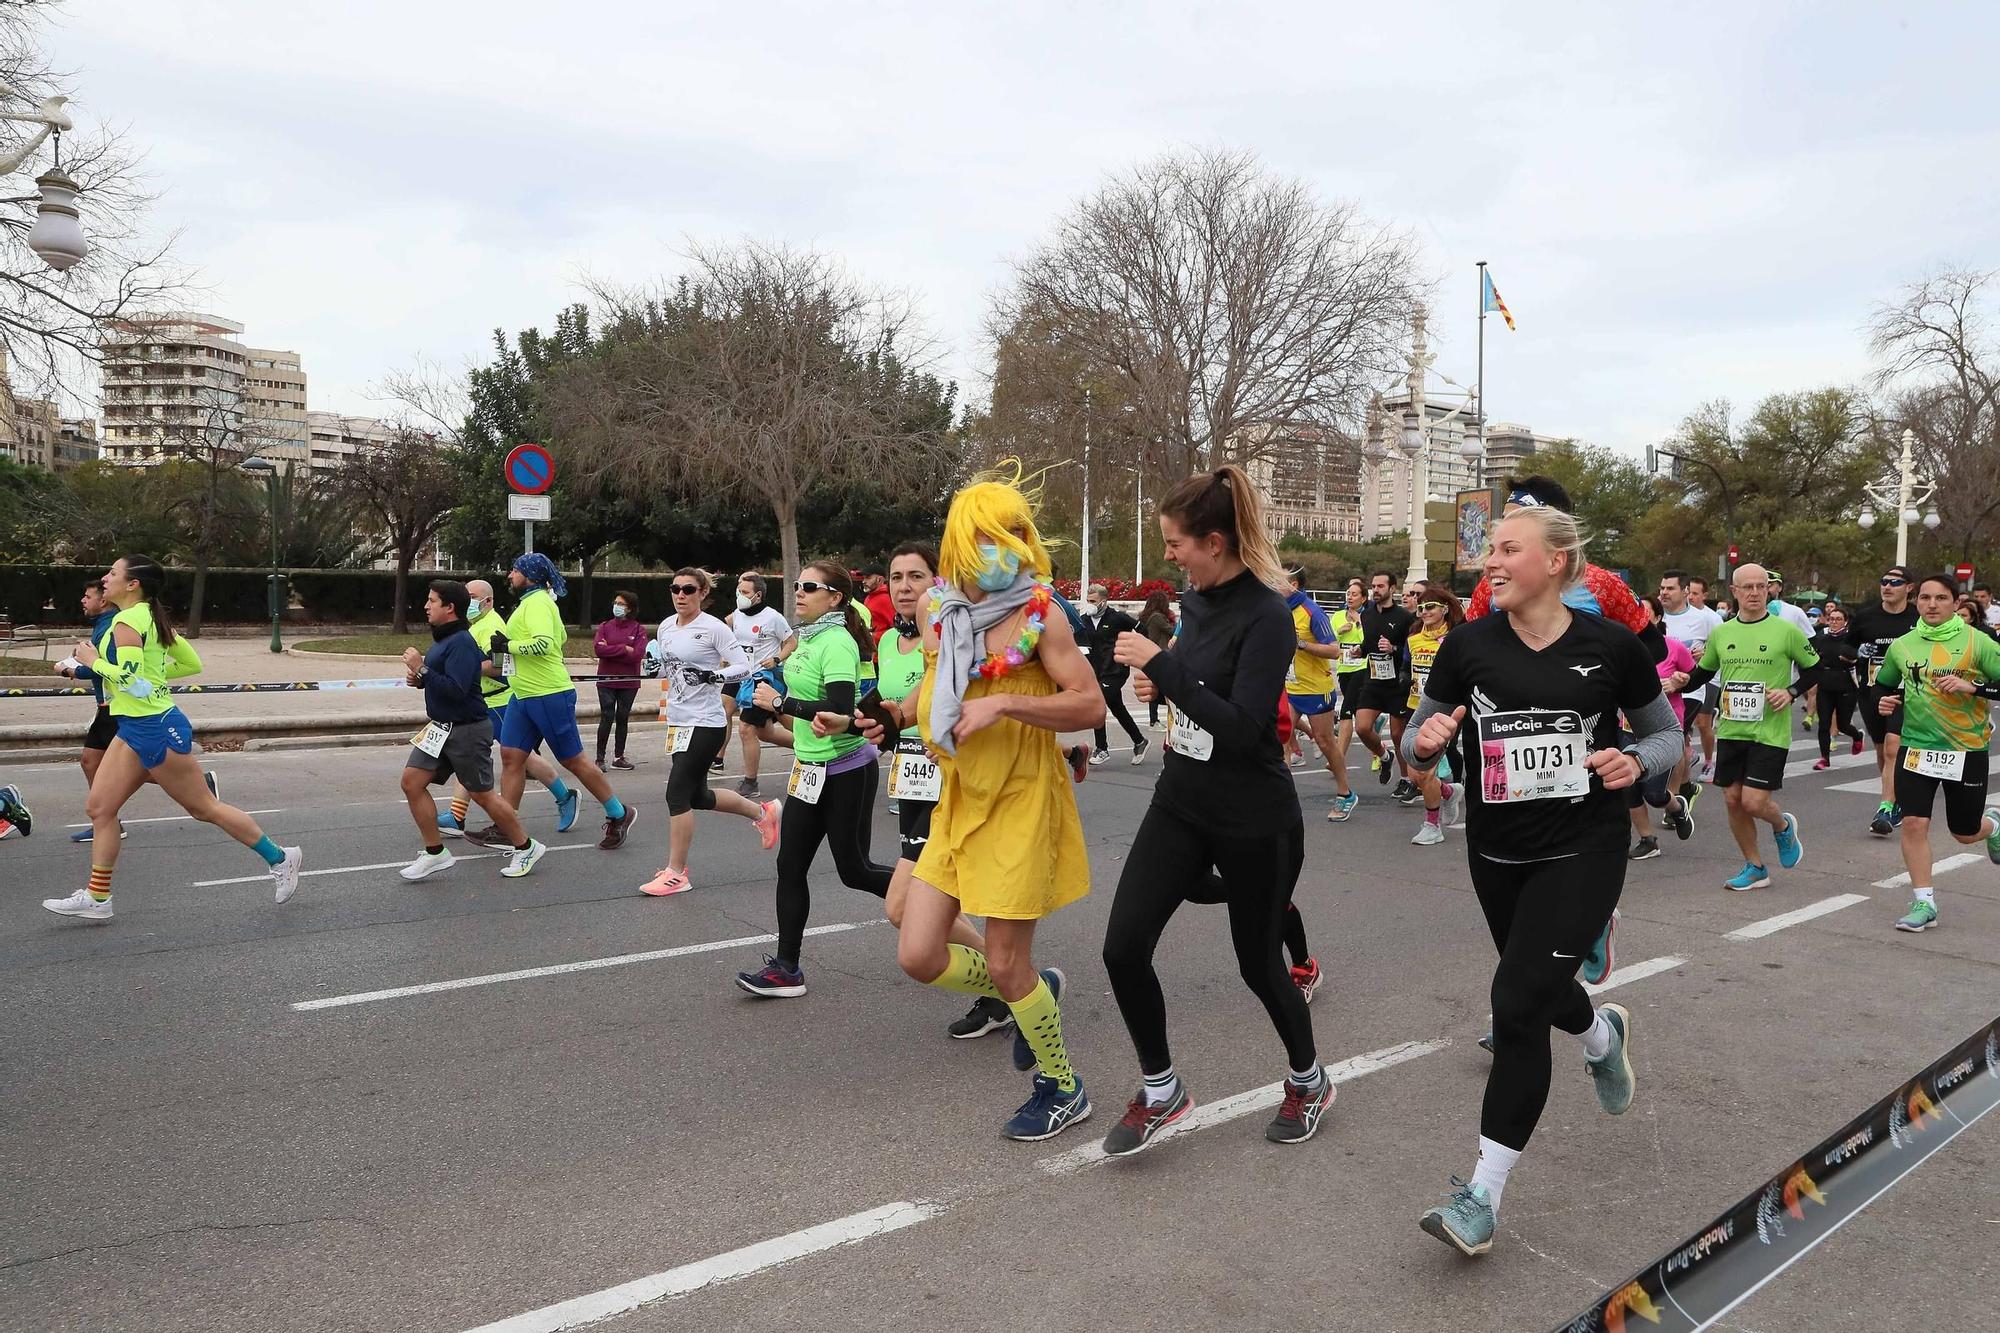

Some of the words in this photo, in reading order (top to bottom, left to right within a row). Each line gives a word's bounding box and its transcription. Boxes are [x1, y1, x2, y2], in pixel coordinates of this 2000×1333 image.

[1733, 697, 1757, 708] 6458
[1491, 719, 1543, 734] iberCaja
[1511, 743, 1573, 771] 10731
[1926, 751, 1956, 766] 5192
[903, 762, 936, 779] 5449
[1536, 770, 1555, 780] MIMI
[1492, 783, 1506, 795] 05
[1825, 1125, 1873, 1166] #MadeToRun
[1667, 1218, 1734, 1273] #MadeToRun
